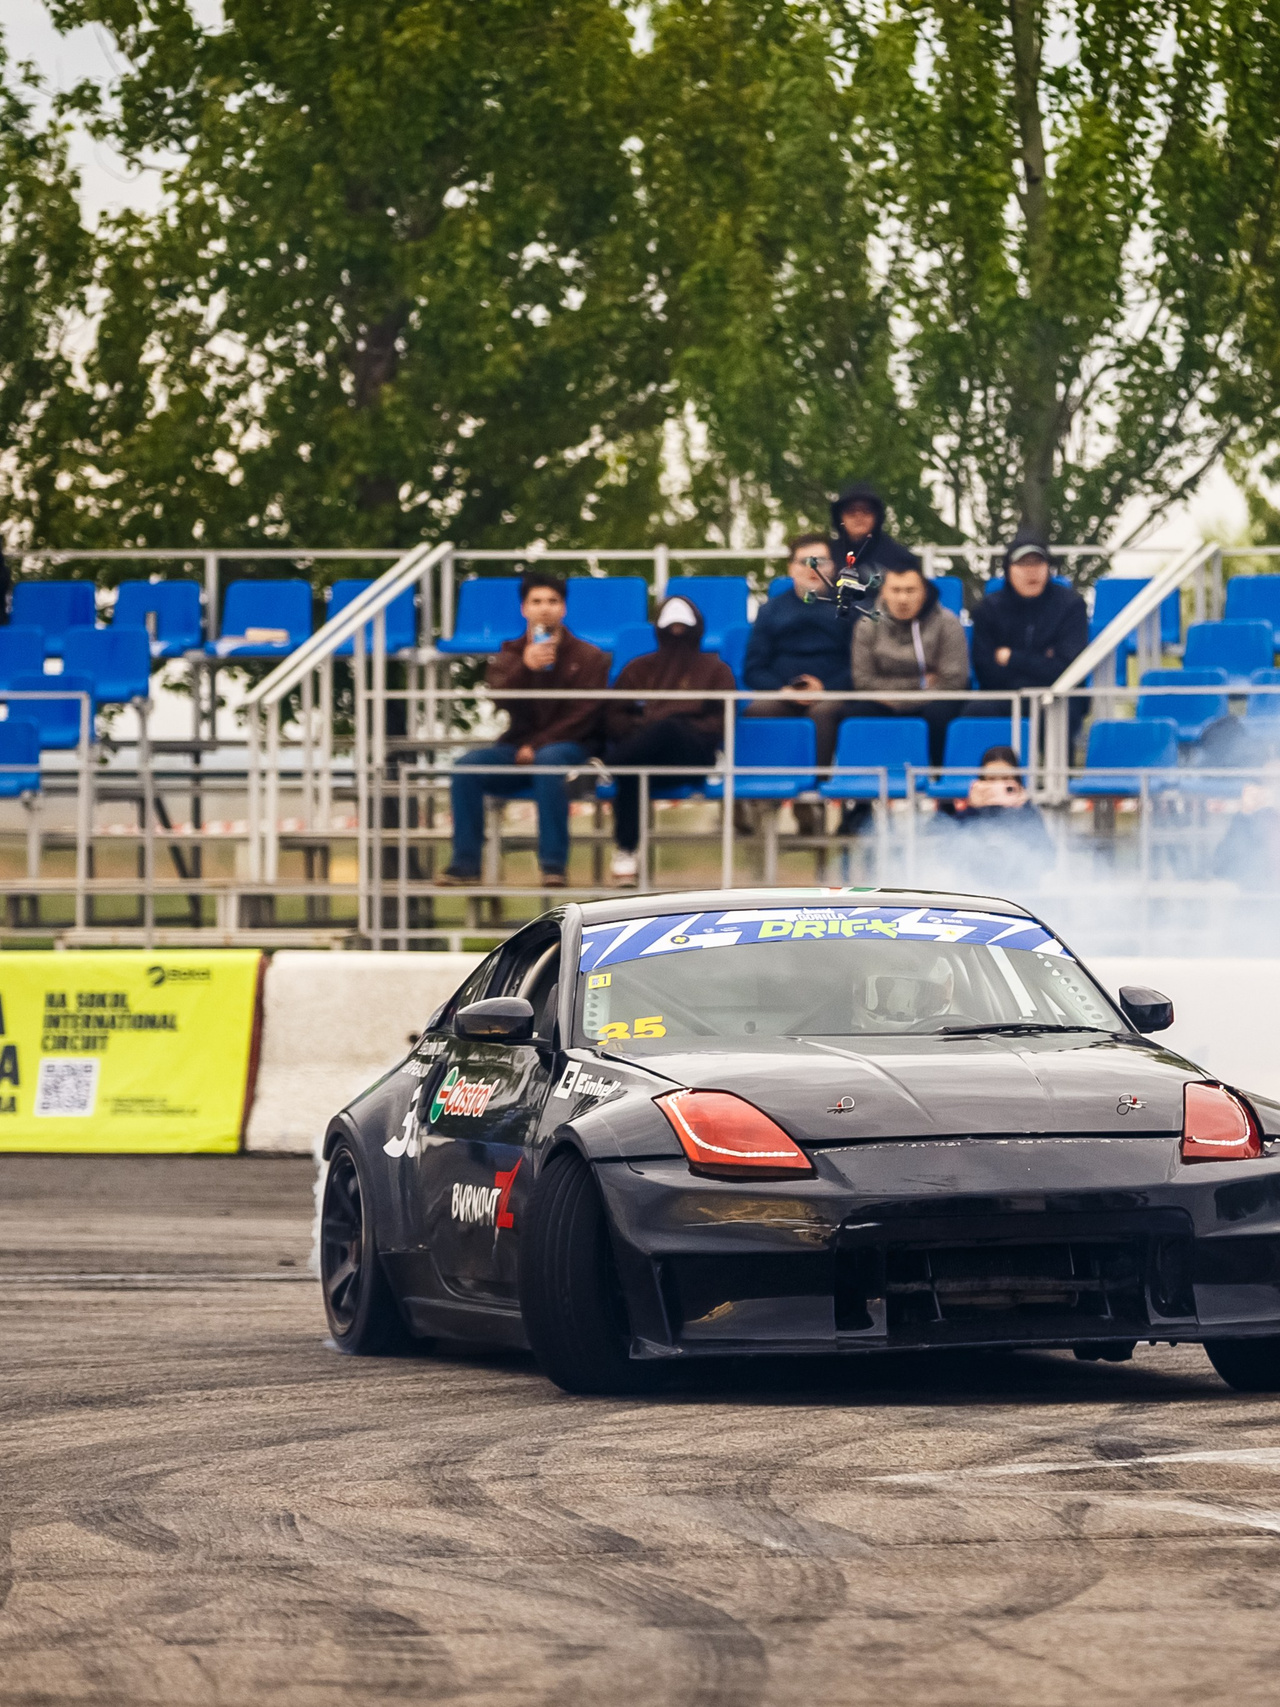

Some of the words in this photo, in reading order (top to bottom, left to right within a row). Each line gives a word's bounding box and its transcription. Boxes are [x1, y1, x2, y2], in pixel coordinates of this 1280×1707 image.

[796, 912, 848, 921] GORILLA
[757, 919, 899, 939] DRIFT
[43, 1014, 177, 1030] INTERNATIONAL
[597, 1015, 667, 1046] 35
[41, 1035, 108, 1051] CIRCUIT
[574, 1072, 622, 1097] Einhell
[444, 1076, 500, 1117] Castrol
